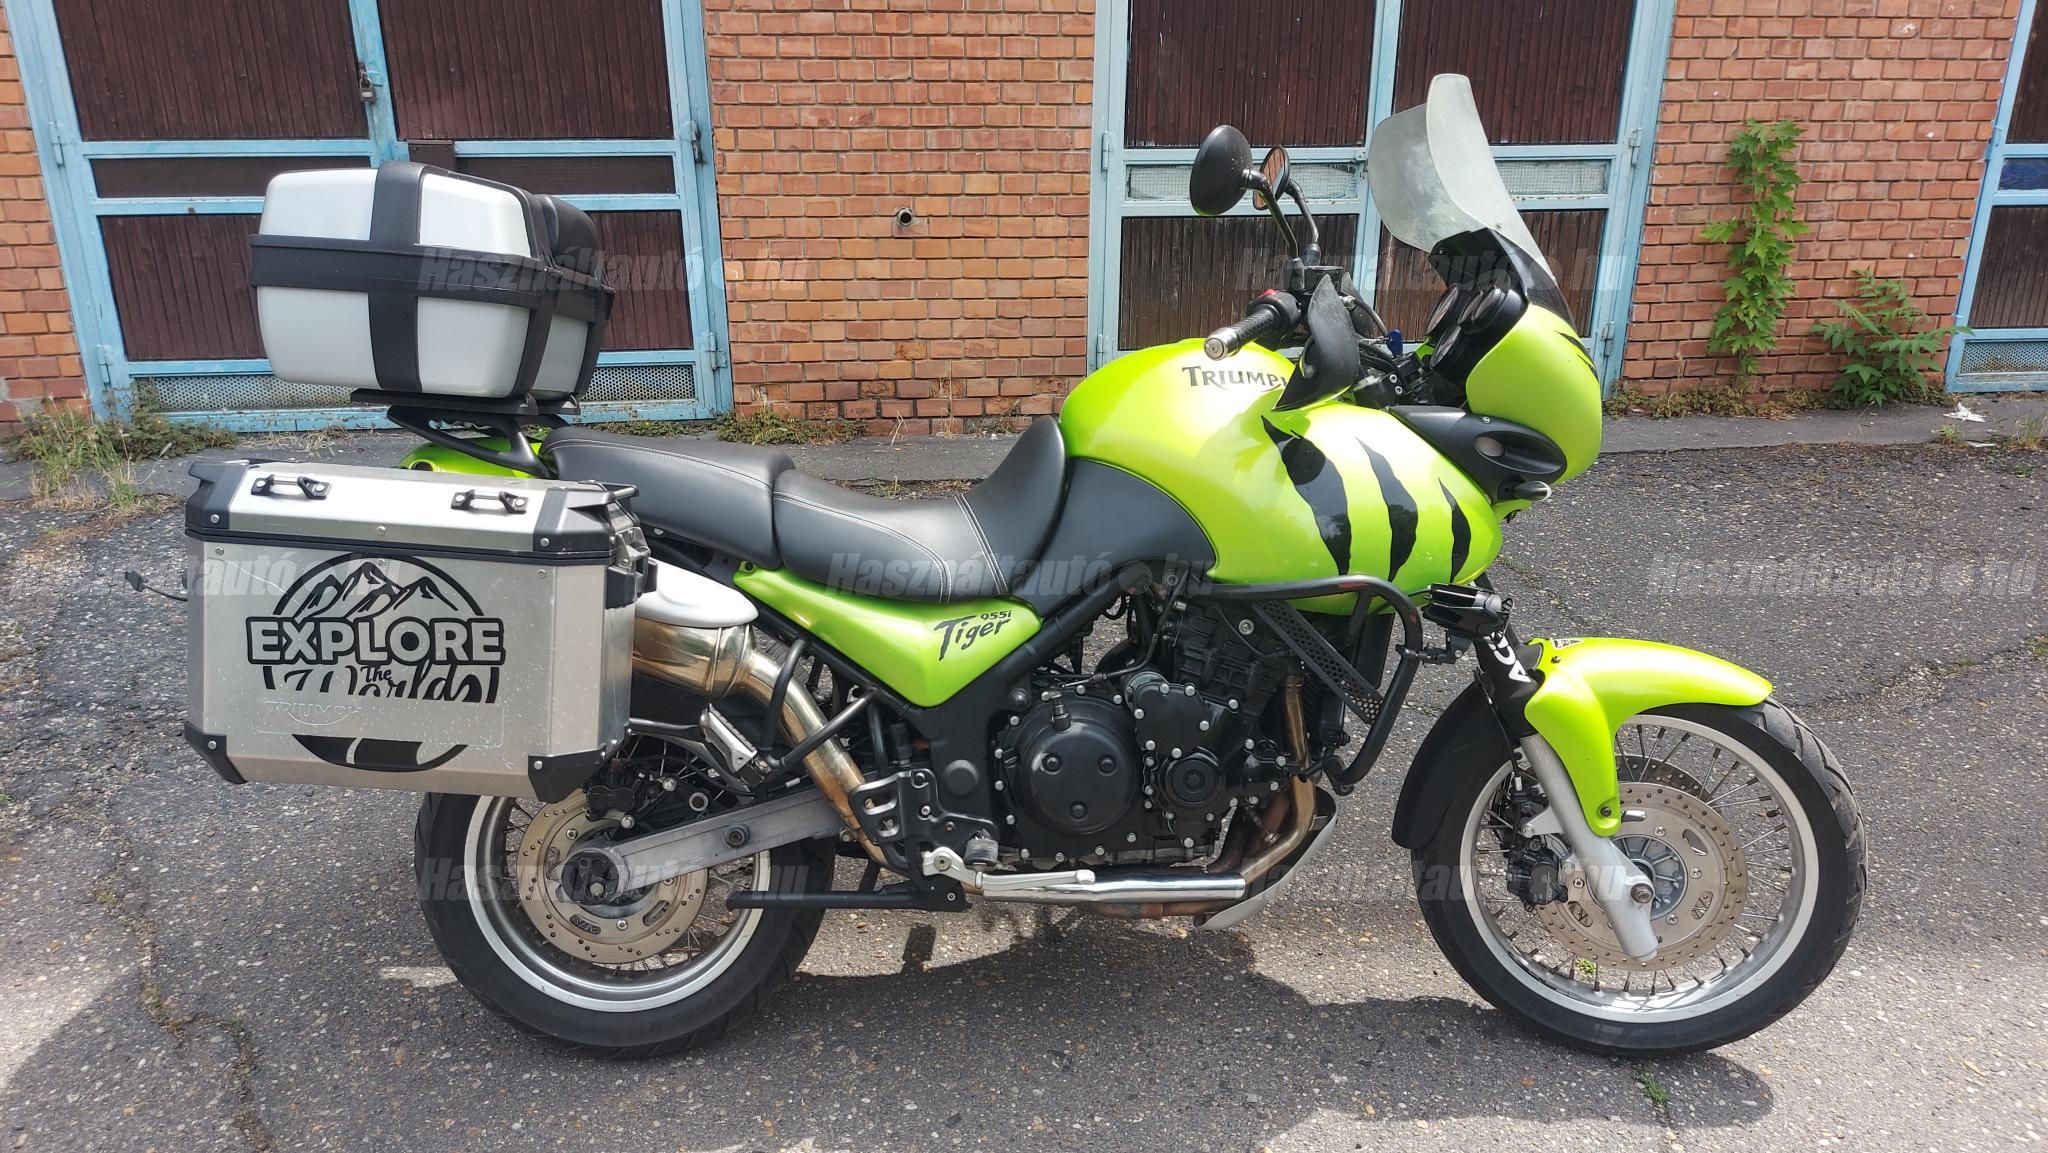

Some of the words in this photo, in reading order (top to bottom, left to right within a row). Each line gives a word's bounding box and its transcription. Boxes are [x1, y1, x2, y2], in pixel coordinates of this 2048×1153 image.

[246, 616, 506, 666] EXPLORE
[933, 614, 1011, 662] Tiger
[359, 664, 393, 683] The
